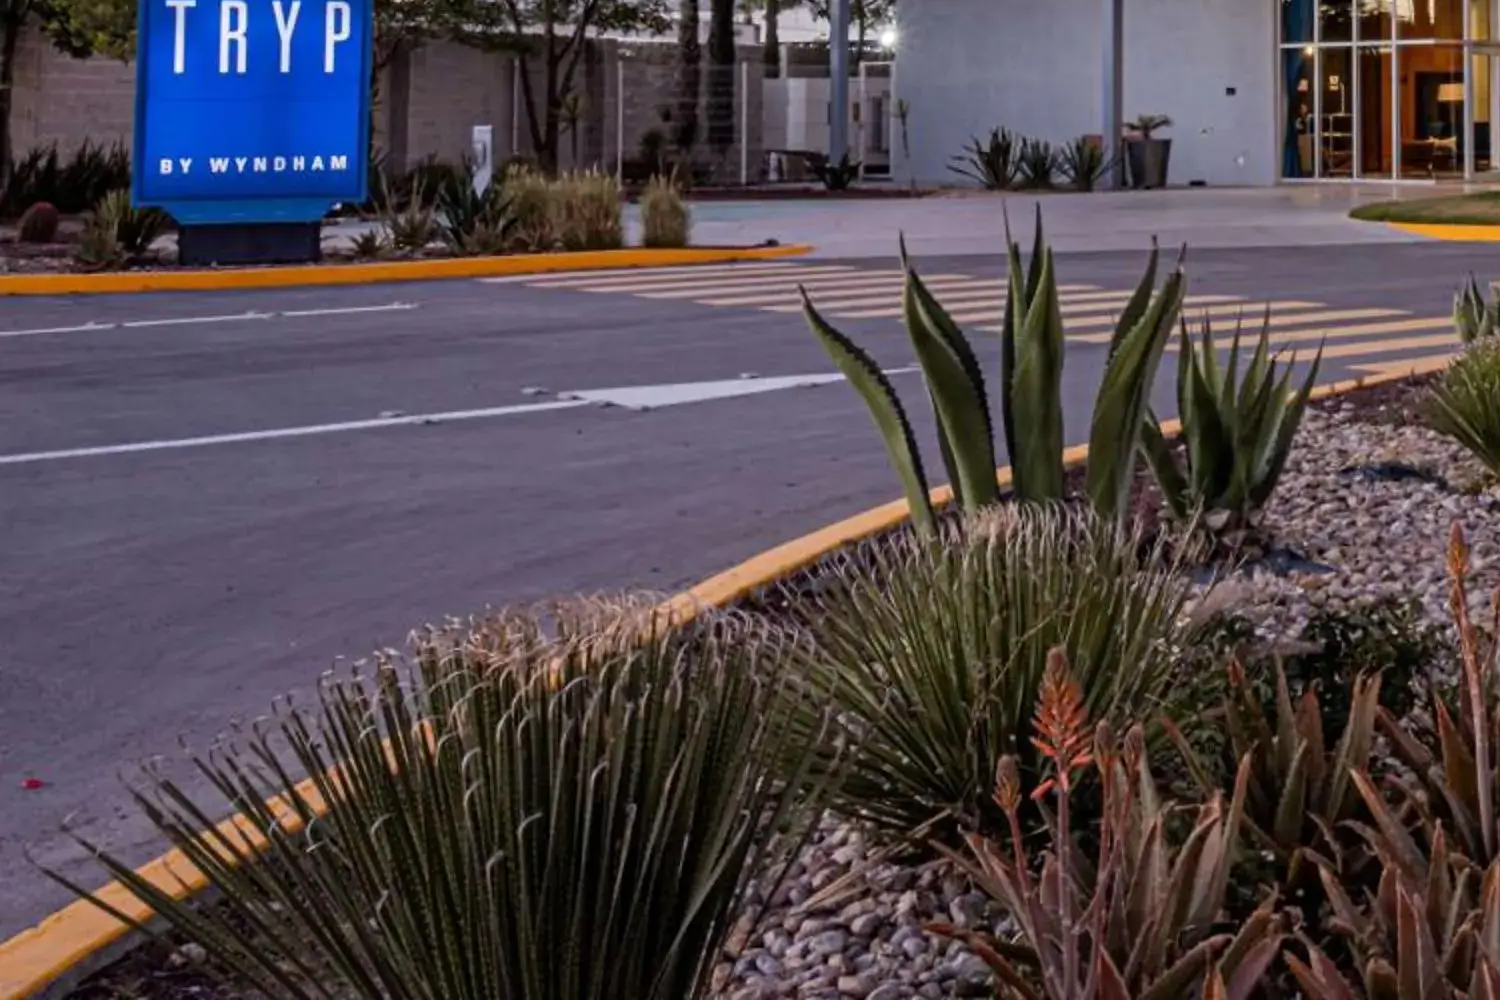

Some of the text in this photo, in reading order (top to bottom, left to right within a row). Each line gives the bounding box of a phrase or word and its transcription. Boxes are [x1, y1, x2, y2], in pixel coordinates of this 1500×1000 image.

[165, 0, 351, 73] TRYP
[160, 155, 347, 174] BY WYNDHAM
